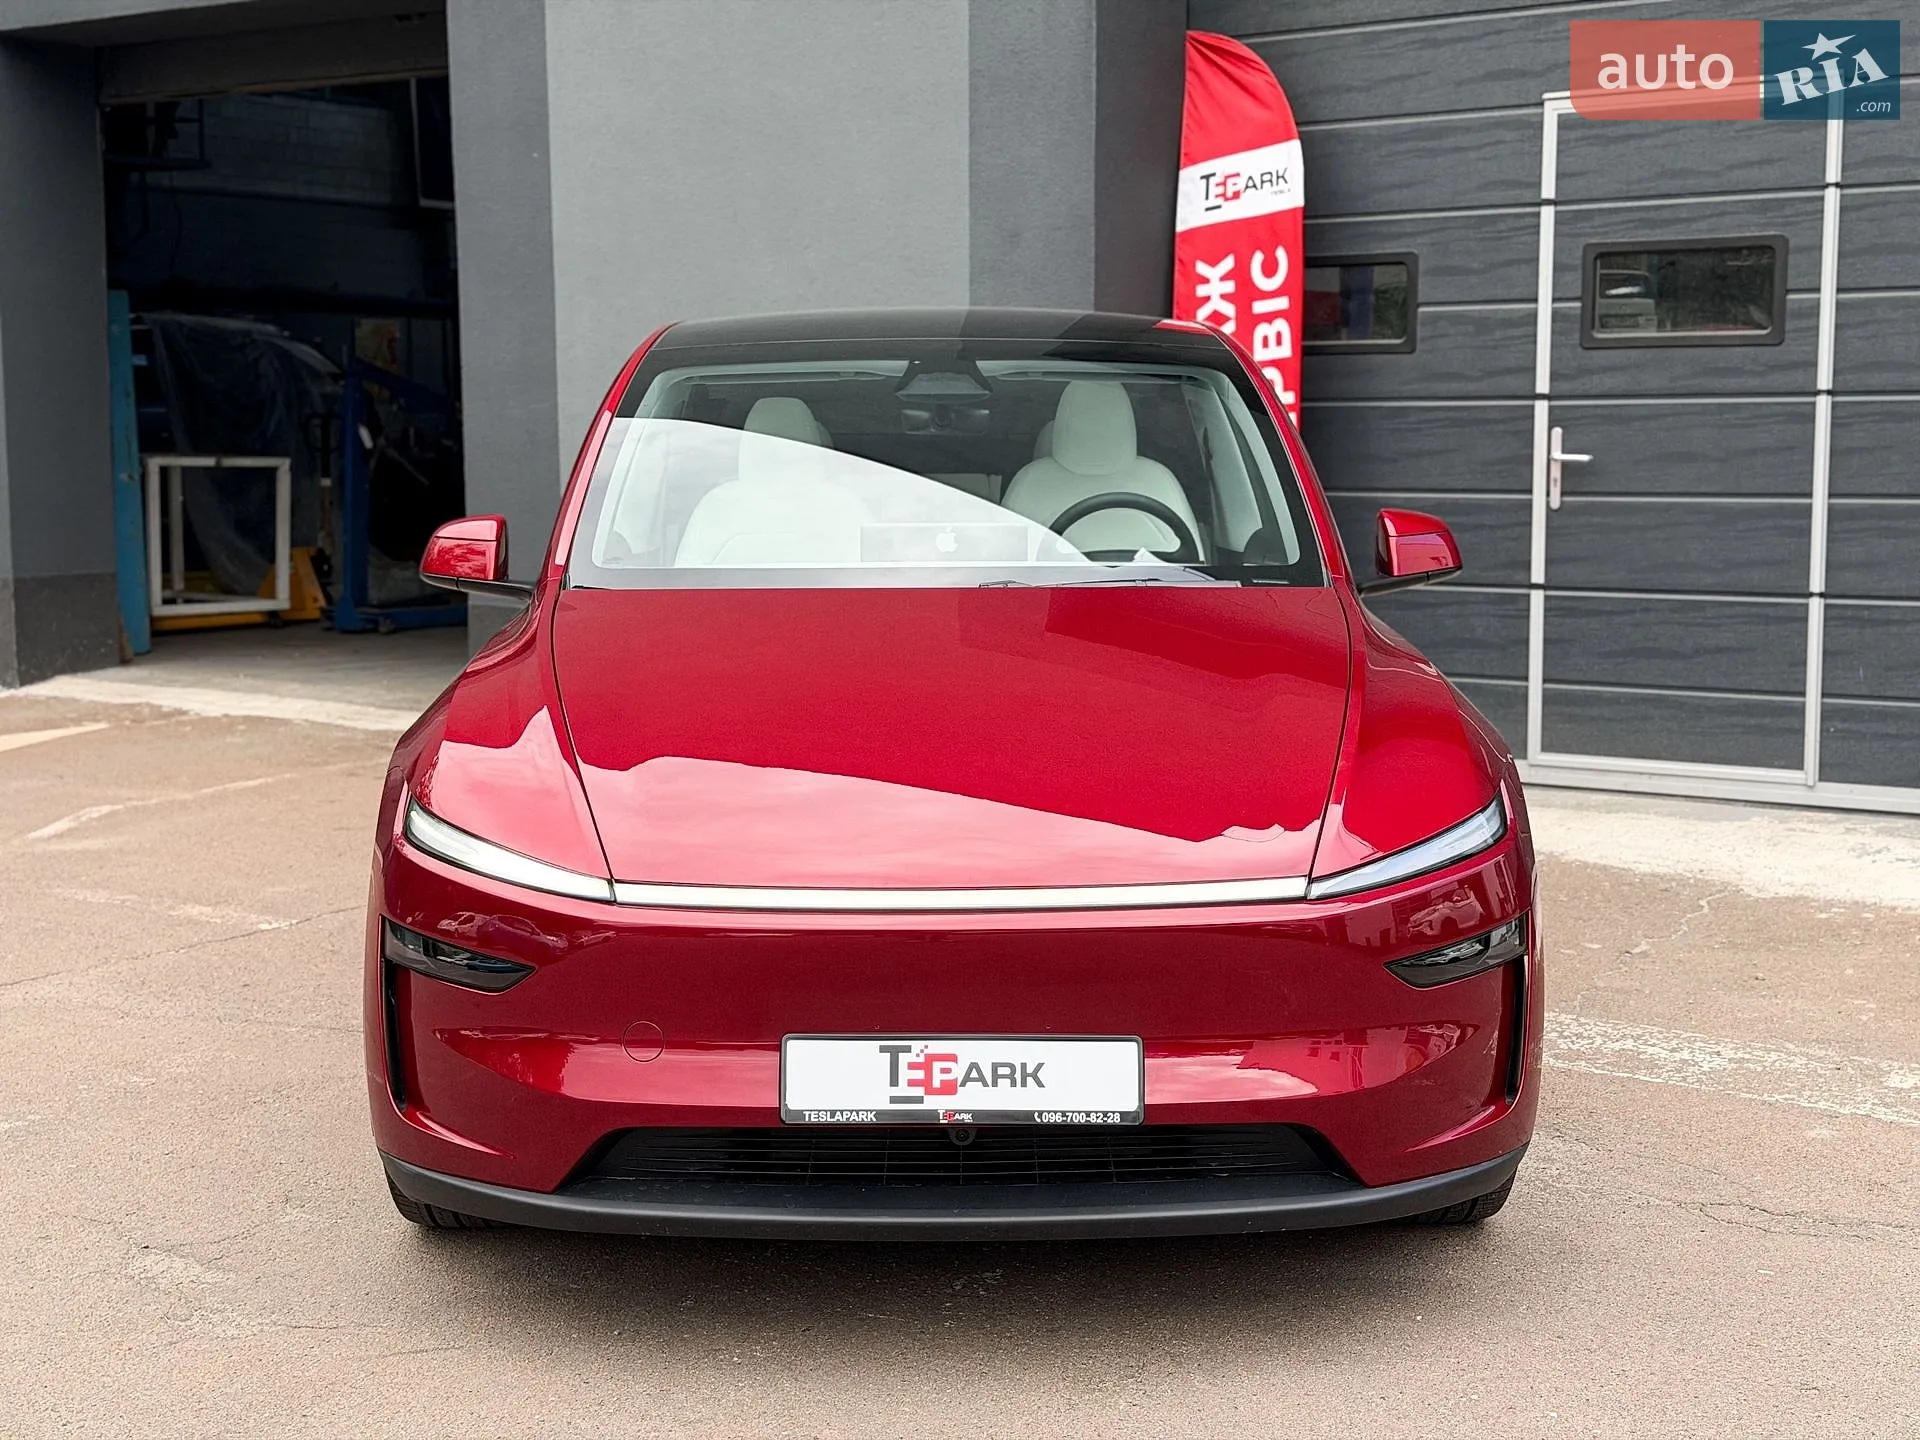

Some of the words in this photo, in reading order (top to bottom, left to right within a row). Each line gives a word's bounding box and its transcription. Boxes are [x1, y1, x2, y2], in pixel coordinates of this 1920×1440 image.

[1251, 245, 1297, 428] РВІС
[803, 1111, 877, 1122] TESLAPARK
[1042, 1112, 1121, 1123] 096-700-82-28
